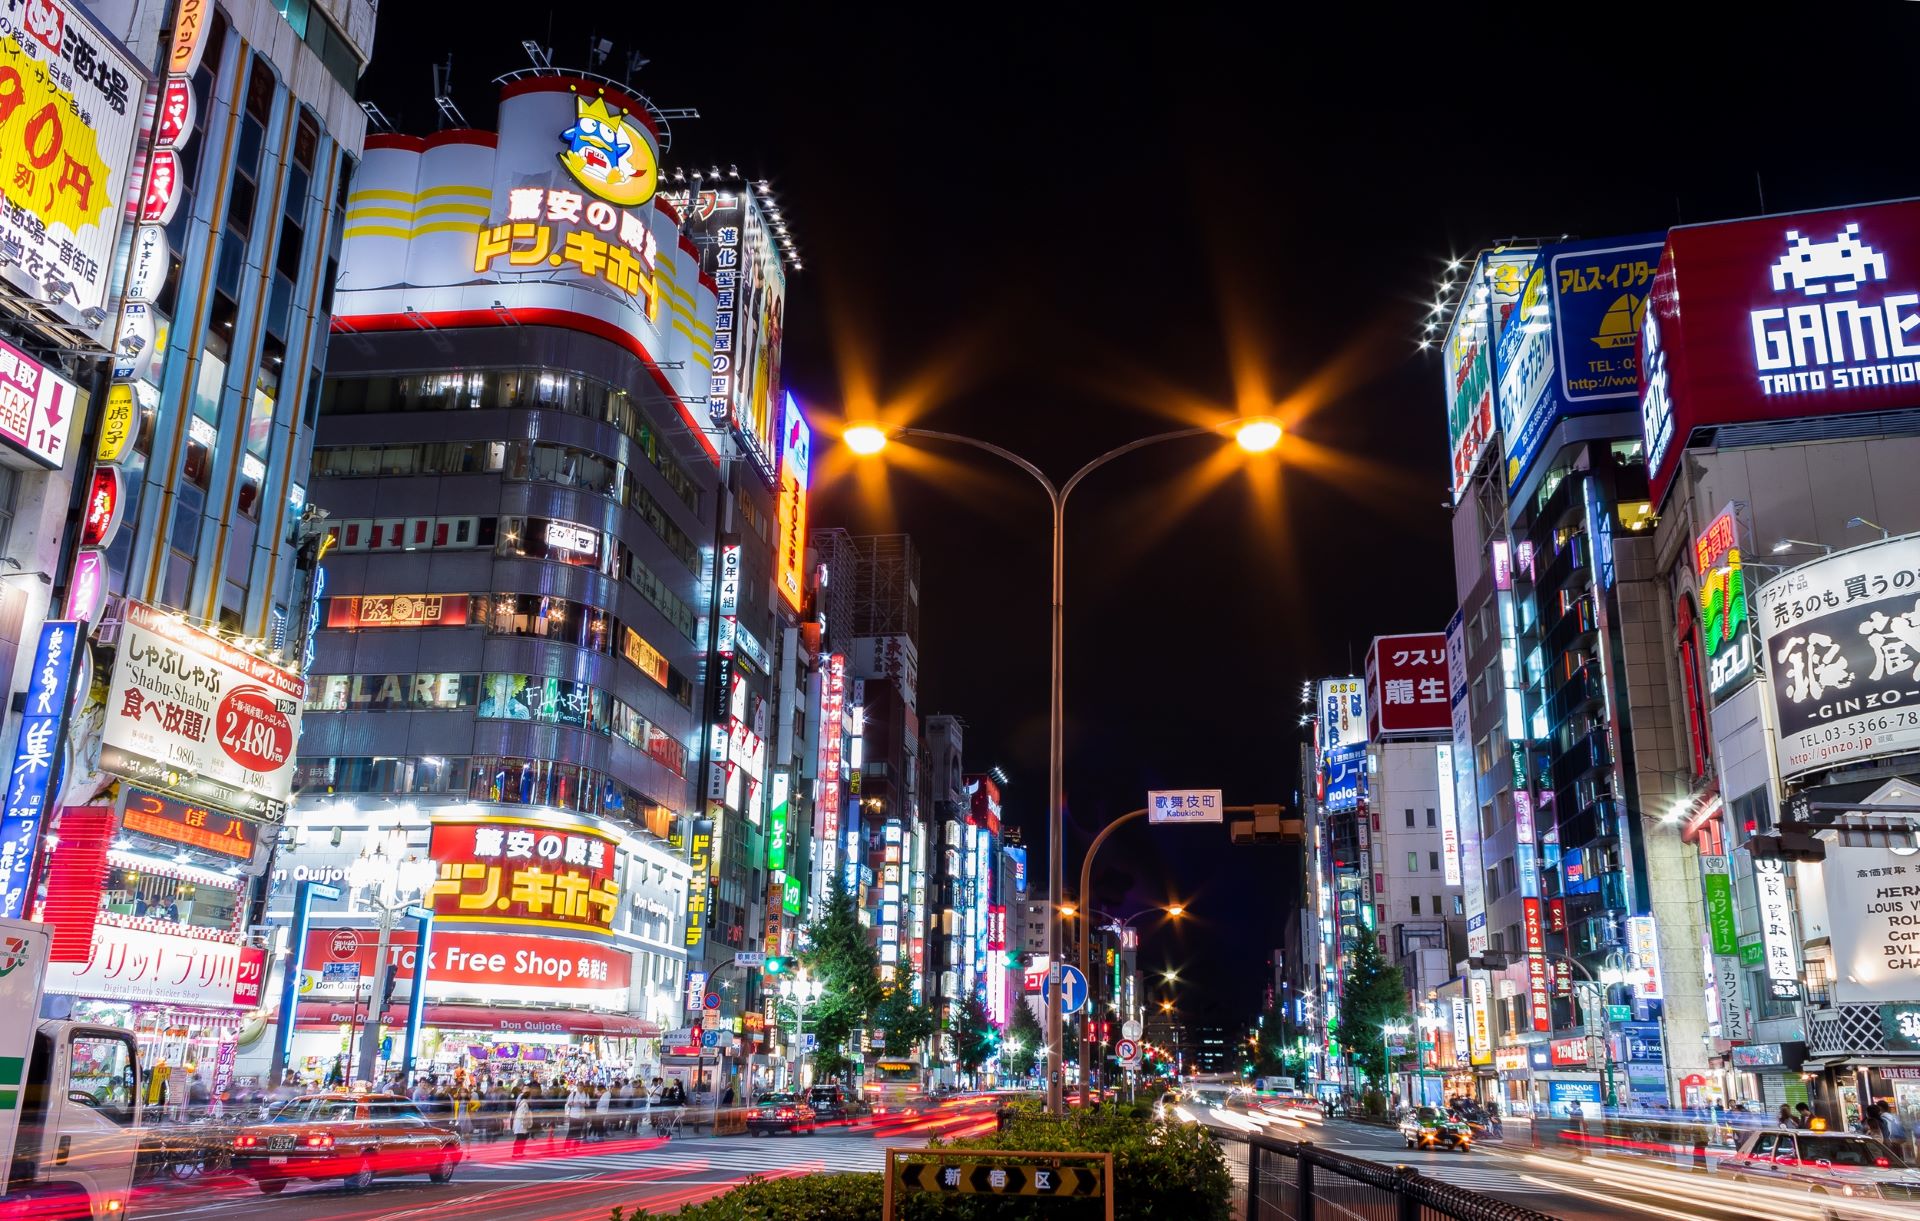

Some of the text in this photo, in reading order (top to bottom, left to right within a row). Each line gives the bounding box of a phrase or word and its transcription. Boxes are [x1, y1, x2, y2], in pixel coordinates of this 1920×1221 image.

[61, 24, 129, 116] 酒場
[1751, 294, 1920, 370] GAME
[117, 369, 130, 377] 5F
[1760, 371, 1826, 394] TAITO
[3, 386, 30, 417] TAX
[105, 407, 129, 444] 虎の子
[36, 429, 61, 455] 1F
[100, 450, 114, 458] 4F
[722, 552, 738, 609] 6年4組
[1762, 573, 1808, 607] ブランド品
[1844, 569, 1920, 604] 買うの
[129, 634, 223, 693] しゃぶしゃぶ
[1392, 650, 1446, 667] クスリ
[275, 672, 303, 697] hours
[1385, 678, 1447, 705] 龍生
[121, 687, 212, 743] 食べ放題!
[222, 712, 276, 760] 2,480
[1789, 736, 1873, 766] http://ginzo.jp
[265, 800, 285, 821] 5F
[1155, 795, 1215, 809] 歌舞伎町
[1166, 808, 1205, 818] Kabukicho
[771, 819, 783, 850] レイク
[475, 827, 605, 869] 驚安の殿堂
[293, 864, 352, 884] Quijot
[1855, 866, 1906, 879] 高価買取
[784, 882, 799, 907] レイク
[1867, 901, 1904, 915] LOUIS
[240, 961, 261, 980] プリ
[445, 947, 506, 972] Free
[513, 950, 573, 981] Shop
[577, 960, 608, 982] 免税店
[104, 983, 200, 1000] Digital Photo Sticker Shop
[236, 983, 258, 996] 専門店
[316, 980, 372, 992] Don Quijote
[331, 1013, 394, 1024] Don Qute
[500, 1020, 562, 1034] Don Quijote
[1883, 1068, 1920, 1079] TAX FREE
[1555, 1083, 1594, 1091] SUBNADE
[945, 1168, 1051, 1189] 新宿区
